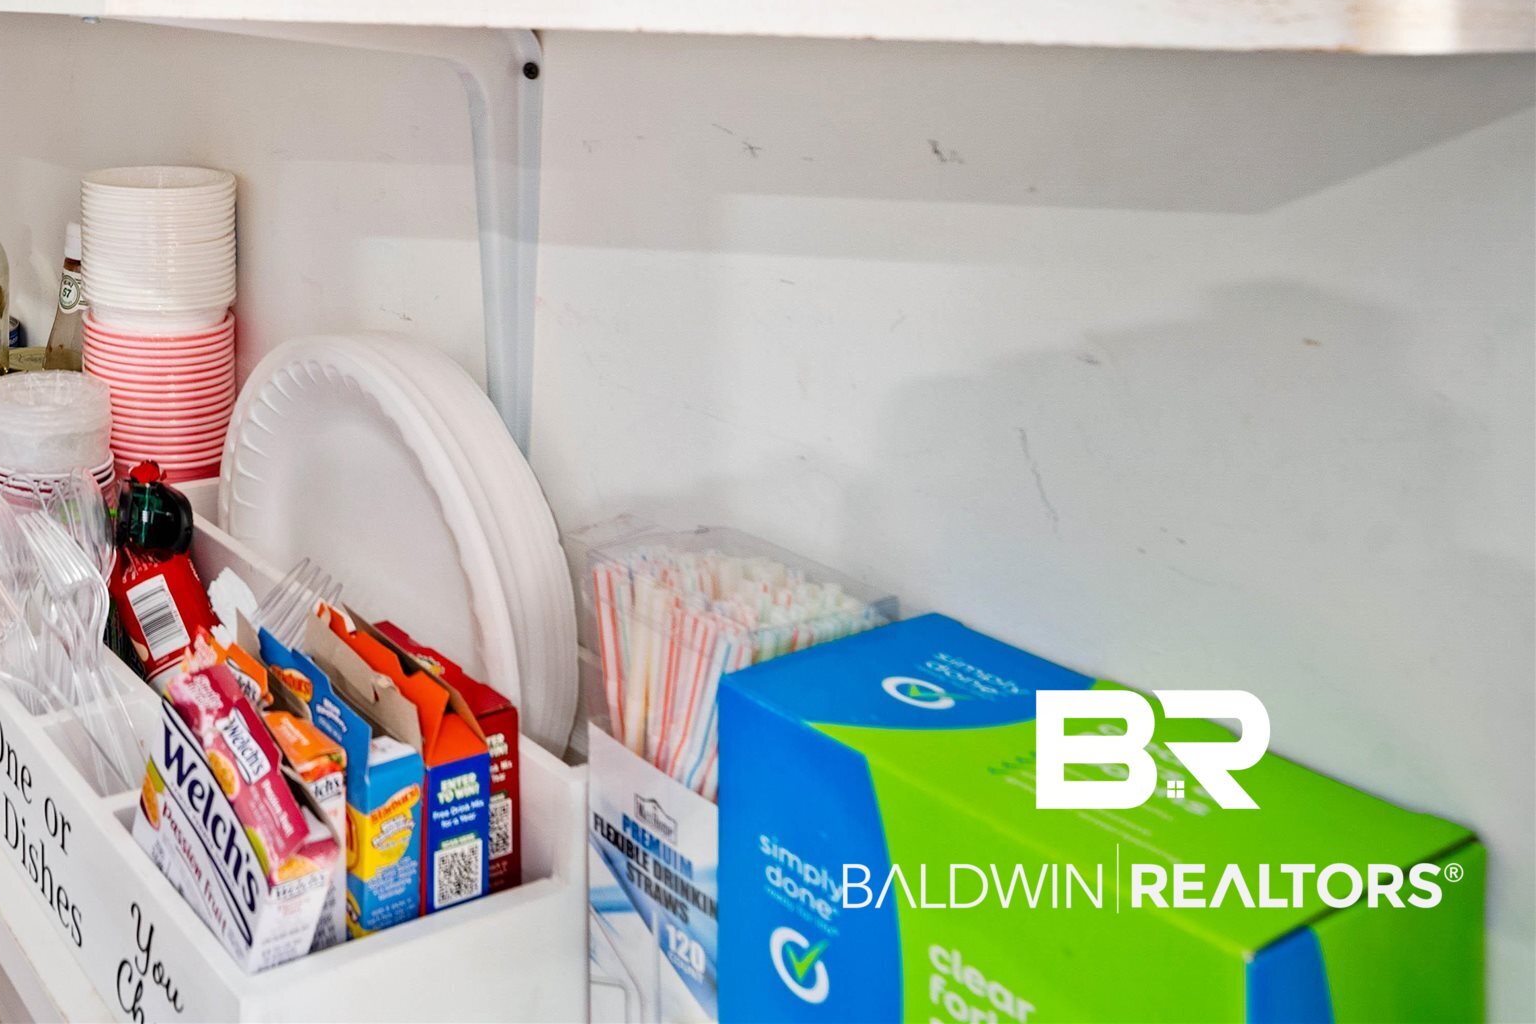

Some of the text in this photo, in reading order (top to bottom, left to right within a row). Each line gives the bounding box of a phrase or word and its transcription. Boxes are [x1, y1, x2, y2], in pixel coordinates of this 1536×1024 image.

[437, 789, 455, 805] TO
[440, 772, 478, 793] ENTER
[43, 795, 72, 857] or
[161, 723, 261, 914] Welch's
[592, 811, 651, 872] FLEXIBLE
[2, 791, 84, 949] Dishes
[161, 801, 204, 883] passion
[203, 874, 227, 936] fruit
[625, 858, 690, 926] STRAWS
[758, 833, 844, 904] simply
[764, 864, 834, 922] done
[130, 901, 185, 1016] You
[666, 924, 706, 976] 120
[927, 943, 1037, 1024] clear
